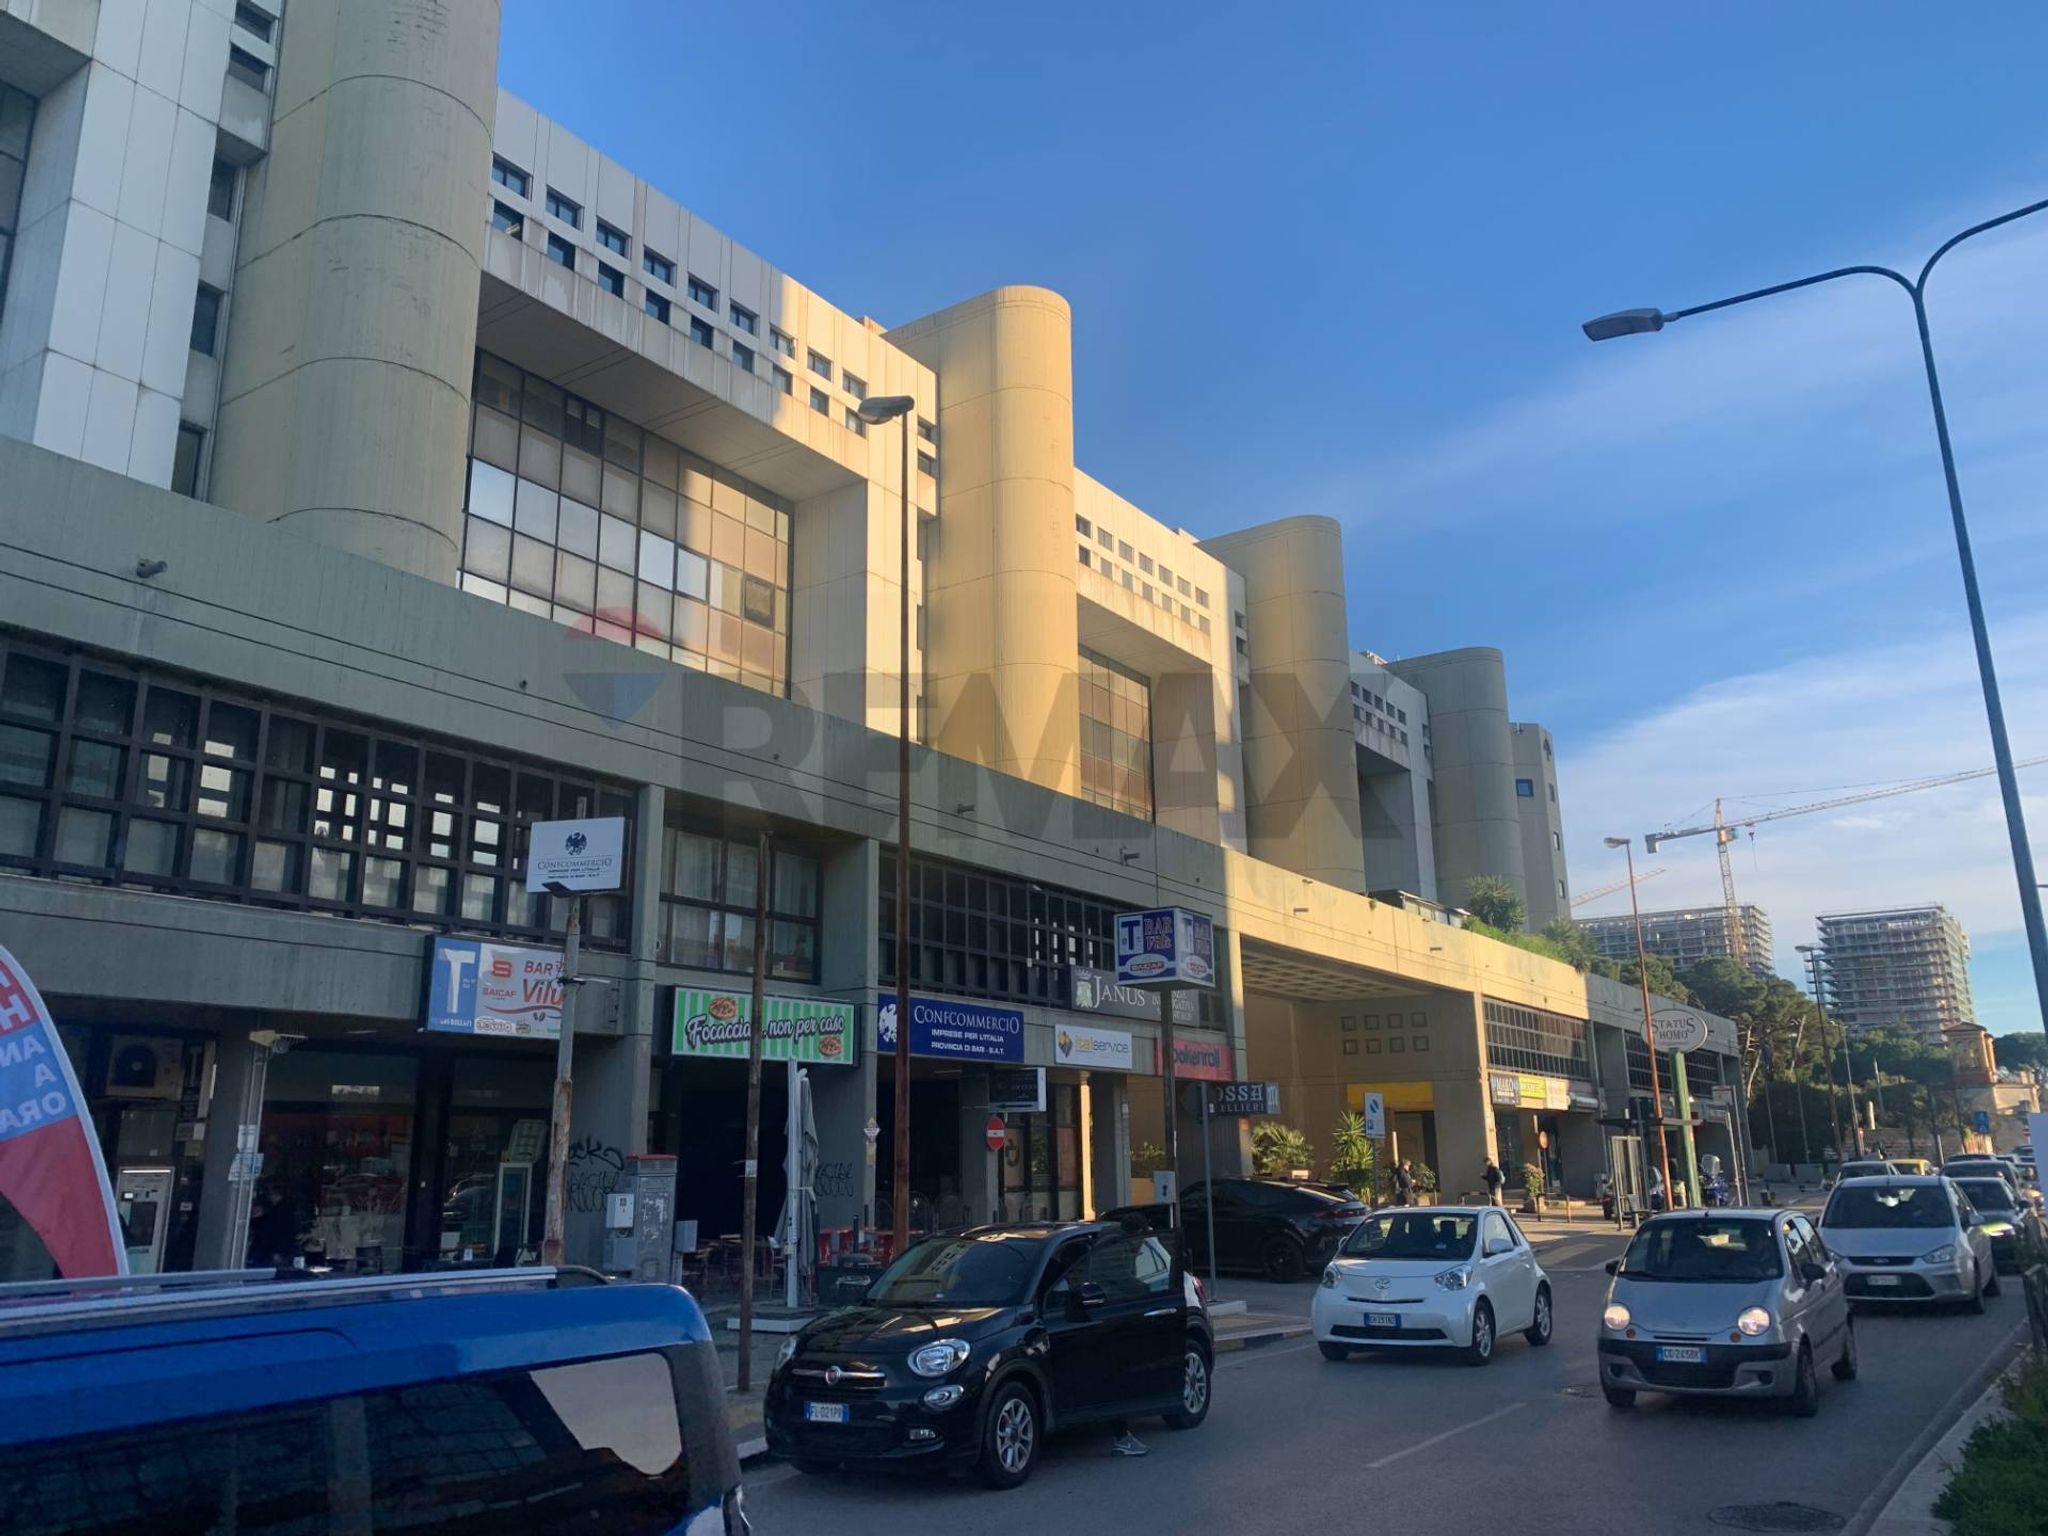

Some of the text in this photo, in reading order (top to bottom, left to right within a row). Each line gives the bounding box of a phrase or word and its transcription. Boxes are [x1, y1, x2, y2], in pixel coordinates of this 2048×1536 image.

[1121, 920, 1141, 950] T
[441, 948, 476, 1014] T
[524, 960, 553, 976] BAR
[1094, 976, 1145, 1008] JANUS
[769, 1018, 793, 1038] non
[796, 1016, 817, 1043] per
[819, 1014, 846, 1034] caso
[914, 1005, 1020, 1034] CONFCOMMERCIO
[1651, 1018, 1696, 1033] STATUS
[931, 1041, 963, 1052] PROVINCIA
[1659, 1030, 1689, 1040] HOMO
